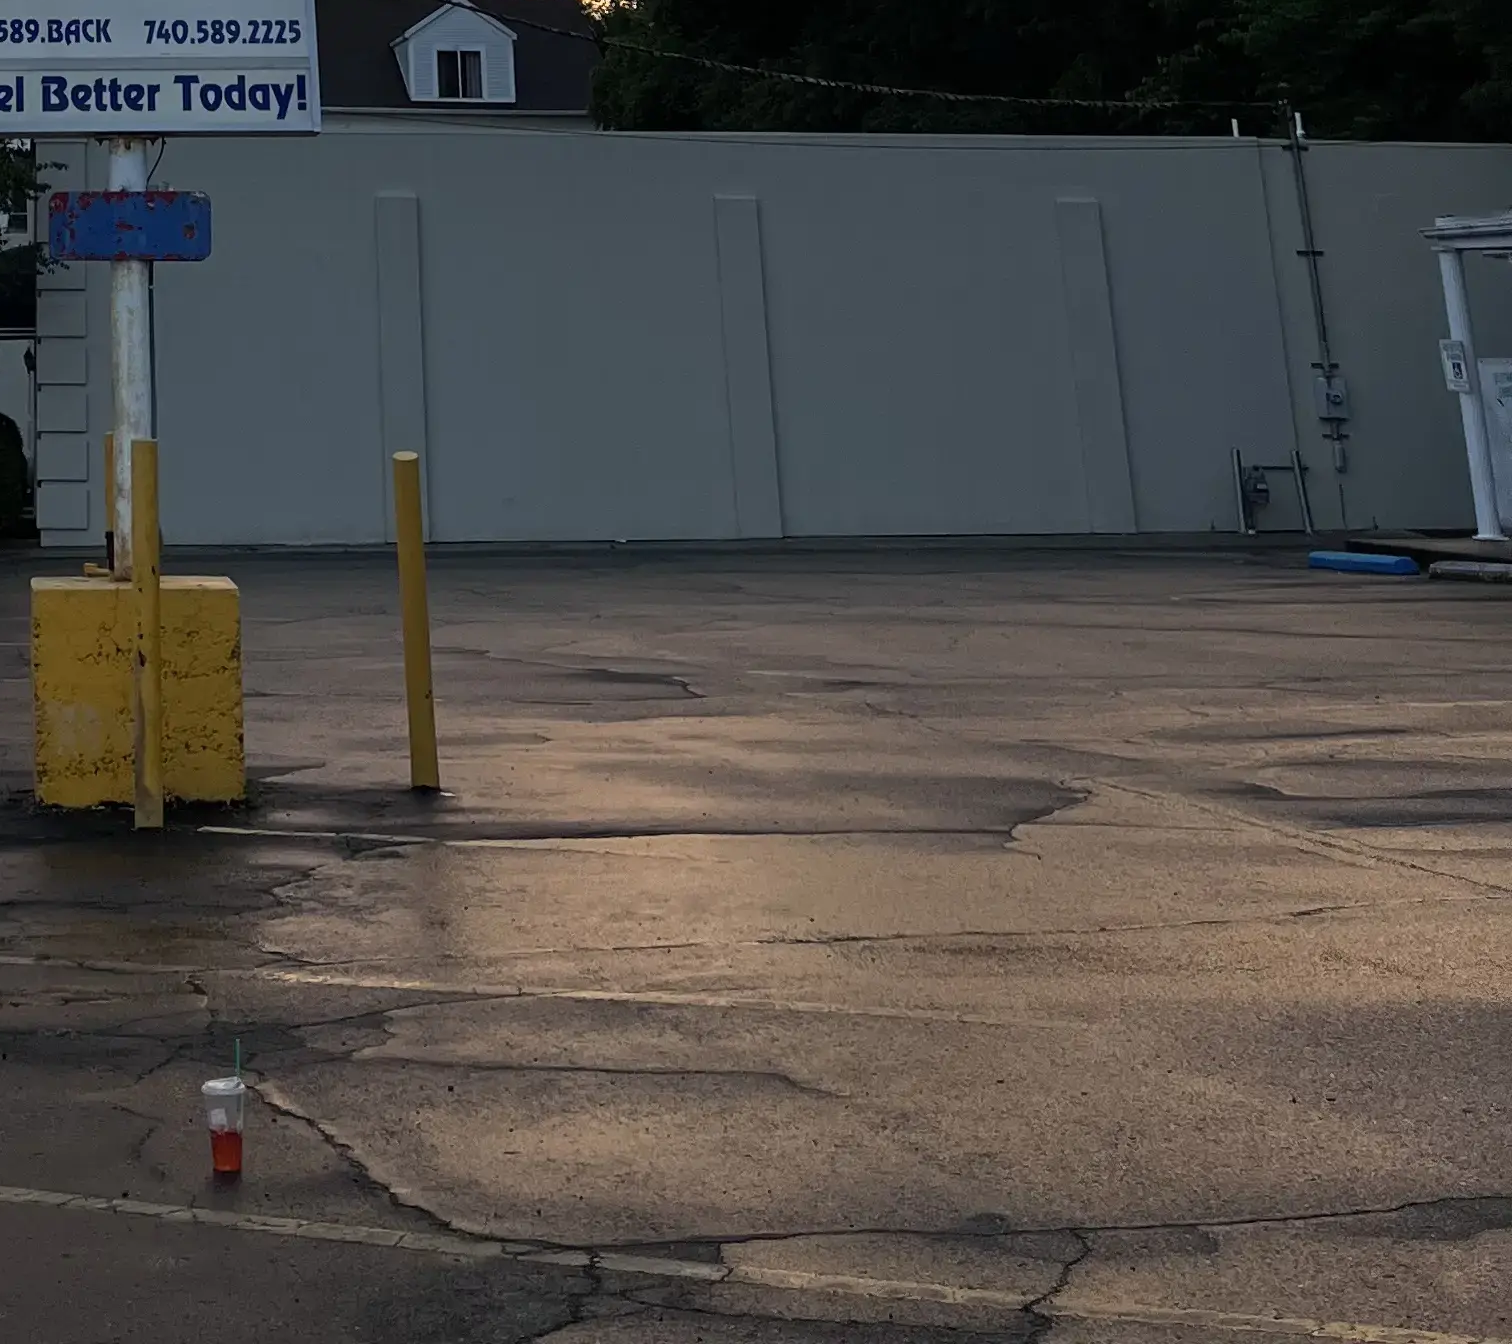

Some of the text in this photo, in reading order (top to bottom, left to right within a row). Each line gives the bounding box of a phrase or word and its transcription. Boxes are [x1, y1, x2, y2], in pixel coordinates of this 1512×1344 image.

[143, 19, 302, 46] 740.589.2225
[40, 75, 161, 112] Better
[173, 74, 308, 120] Today!
